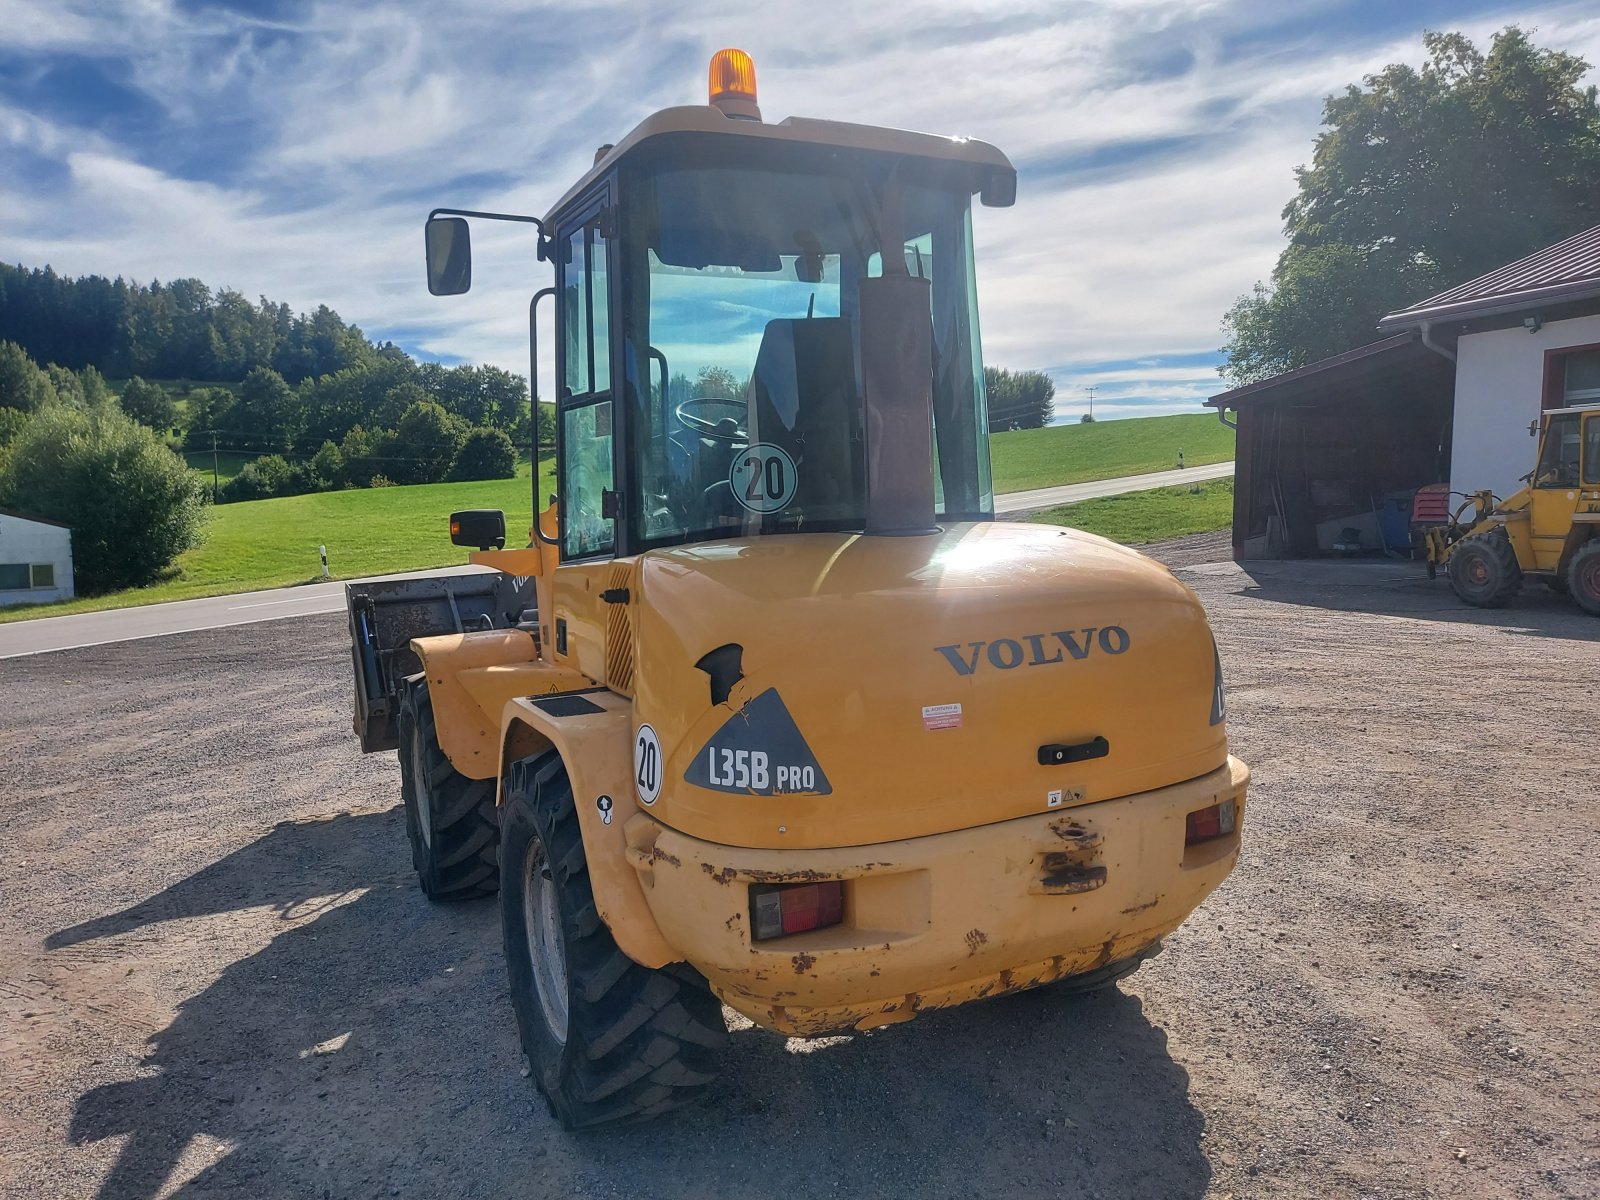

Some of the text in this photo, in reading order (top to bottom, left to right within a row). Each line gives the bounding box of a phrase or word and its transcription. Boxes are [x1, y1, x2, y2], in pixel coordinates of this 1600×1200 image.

[744, 456, 785, 501] 20
[934, 626, 1130, 675] VOLVO
[638, 737, 656, 792] 20
[709, 746, 815, 790] L35B PRO
